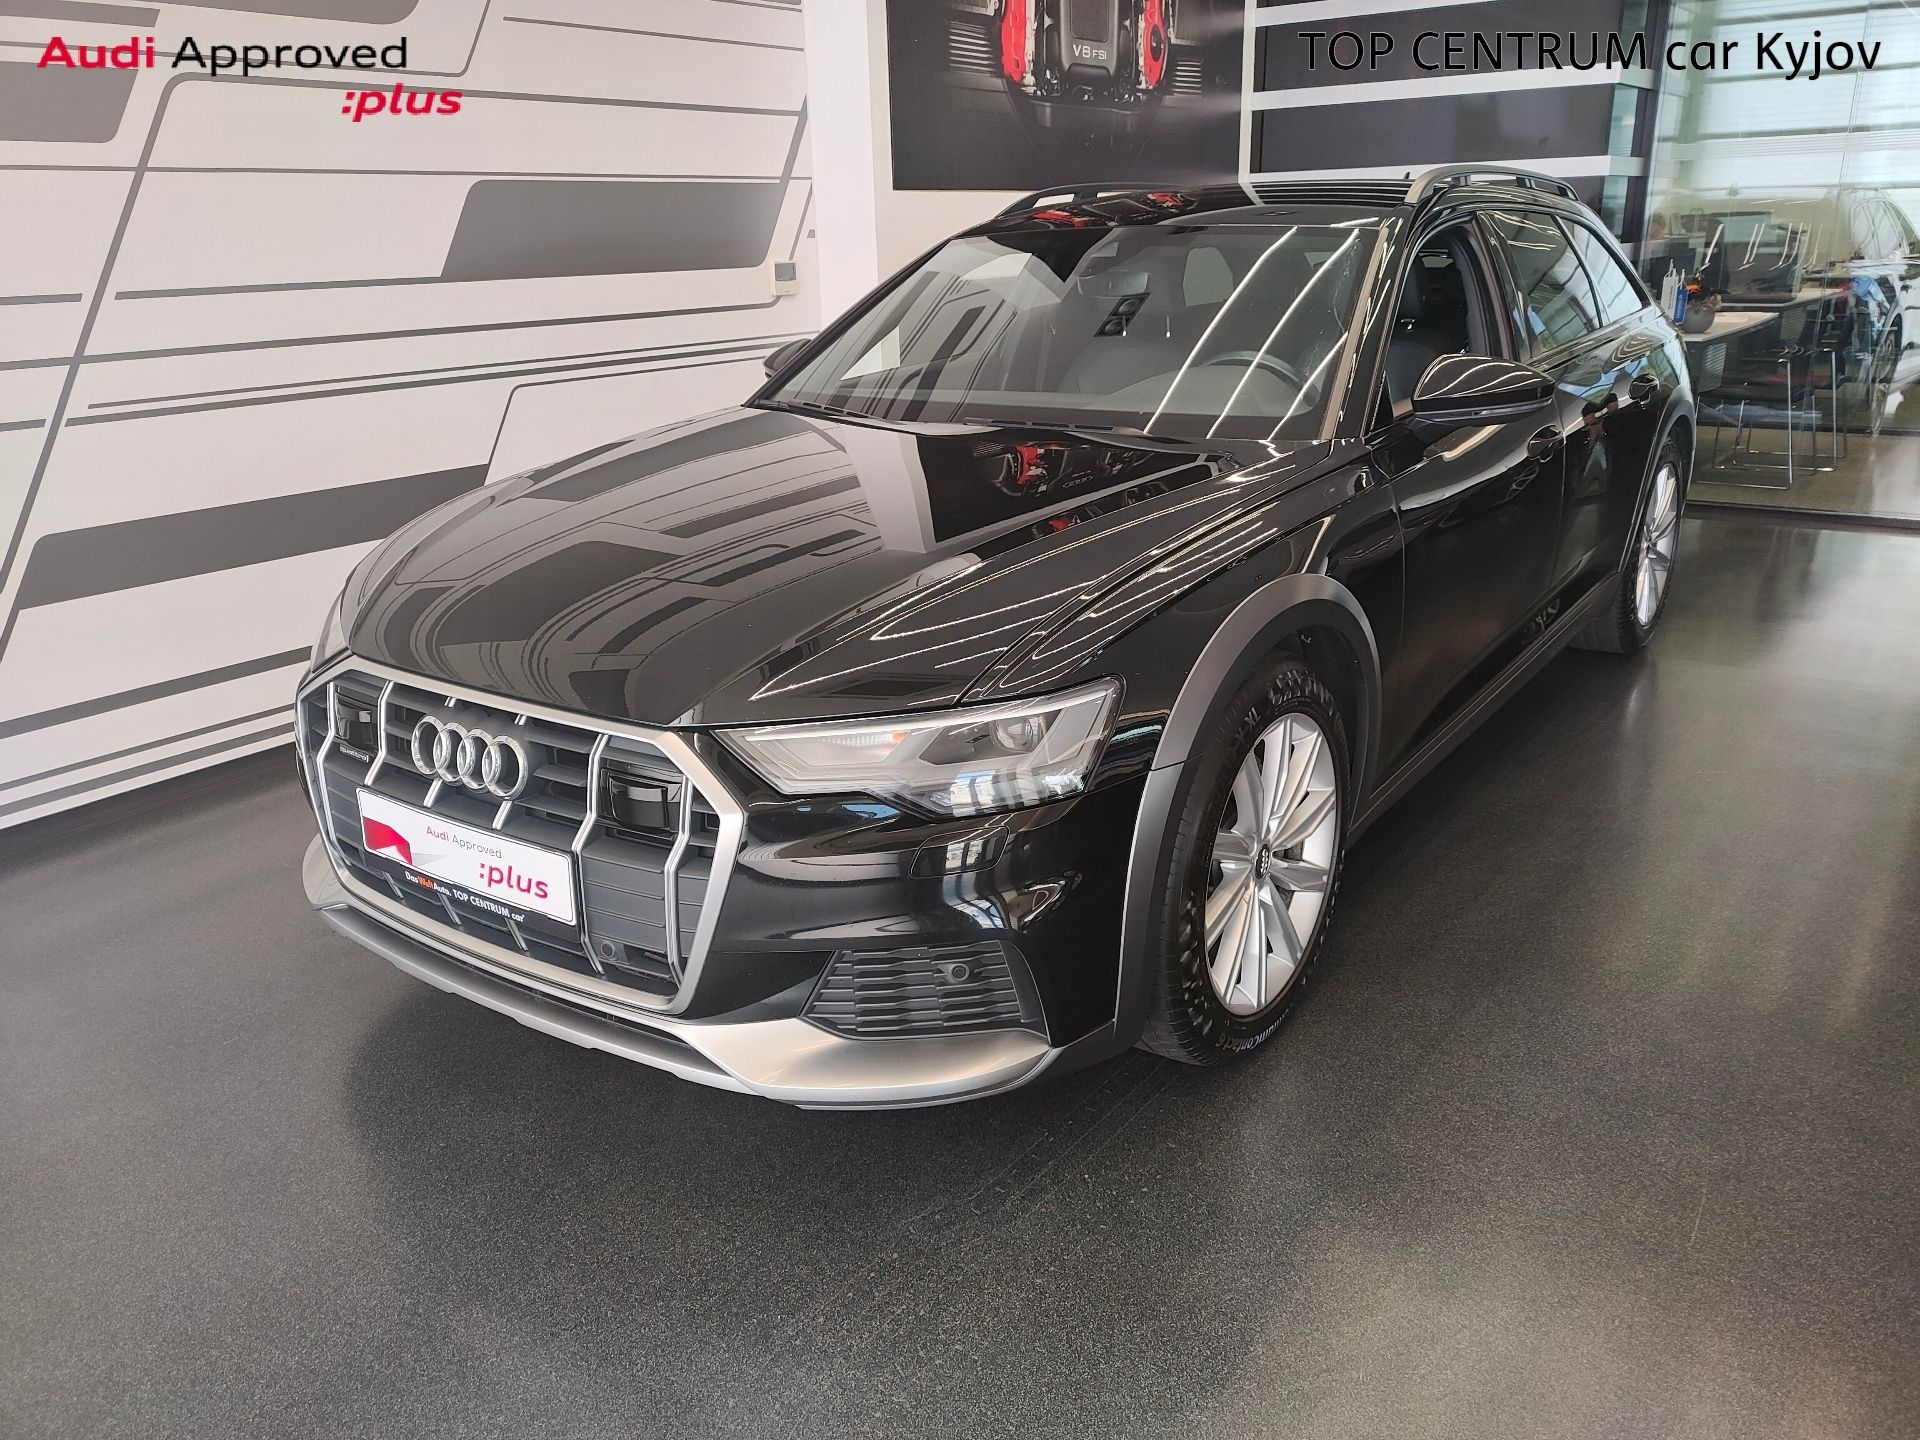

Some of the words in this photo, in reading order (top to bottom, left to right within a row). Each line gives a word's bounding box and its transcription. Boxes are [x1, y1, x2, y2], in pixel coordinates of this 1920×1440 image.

[1072, 44, 1091, 58] V8
[1092, 49, 1107, 60] FSI
[426, 825, 449, 841] Audi
[451, 834, 503, 859] Approved
[479, 862, 549, 899] :plus
[452, 888, 469, 902] TOP
[469, 895, 511, 918] CENTRUM
